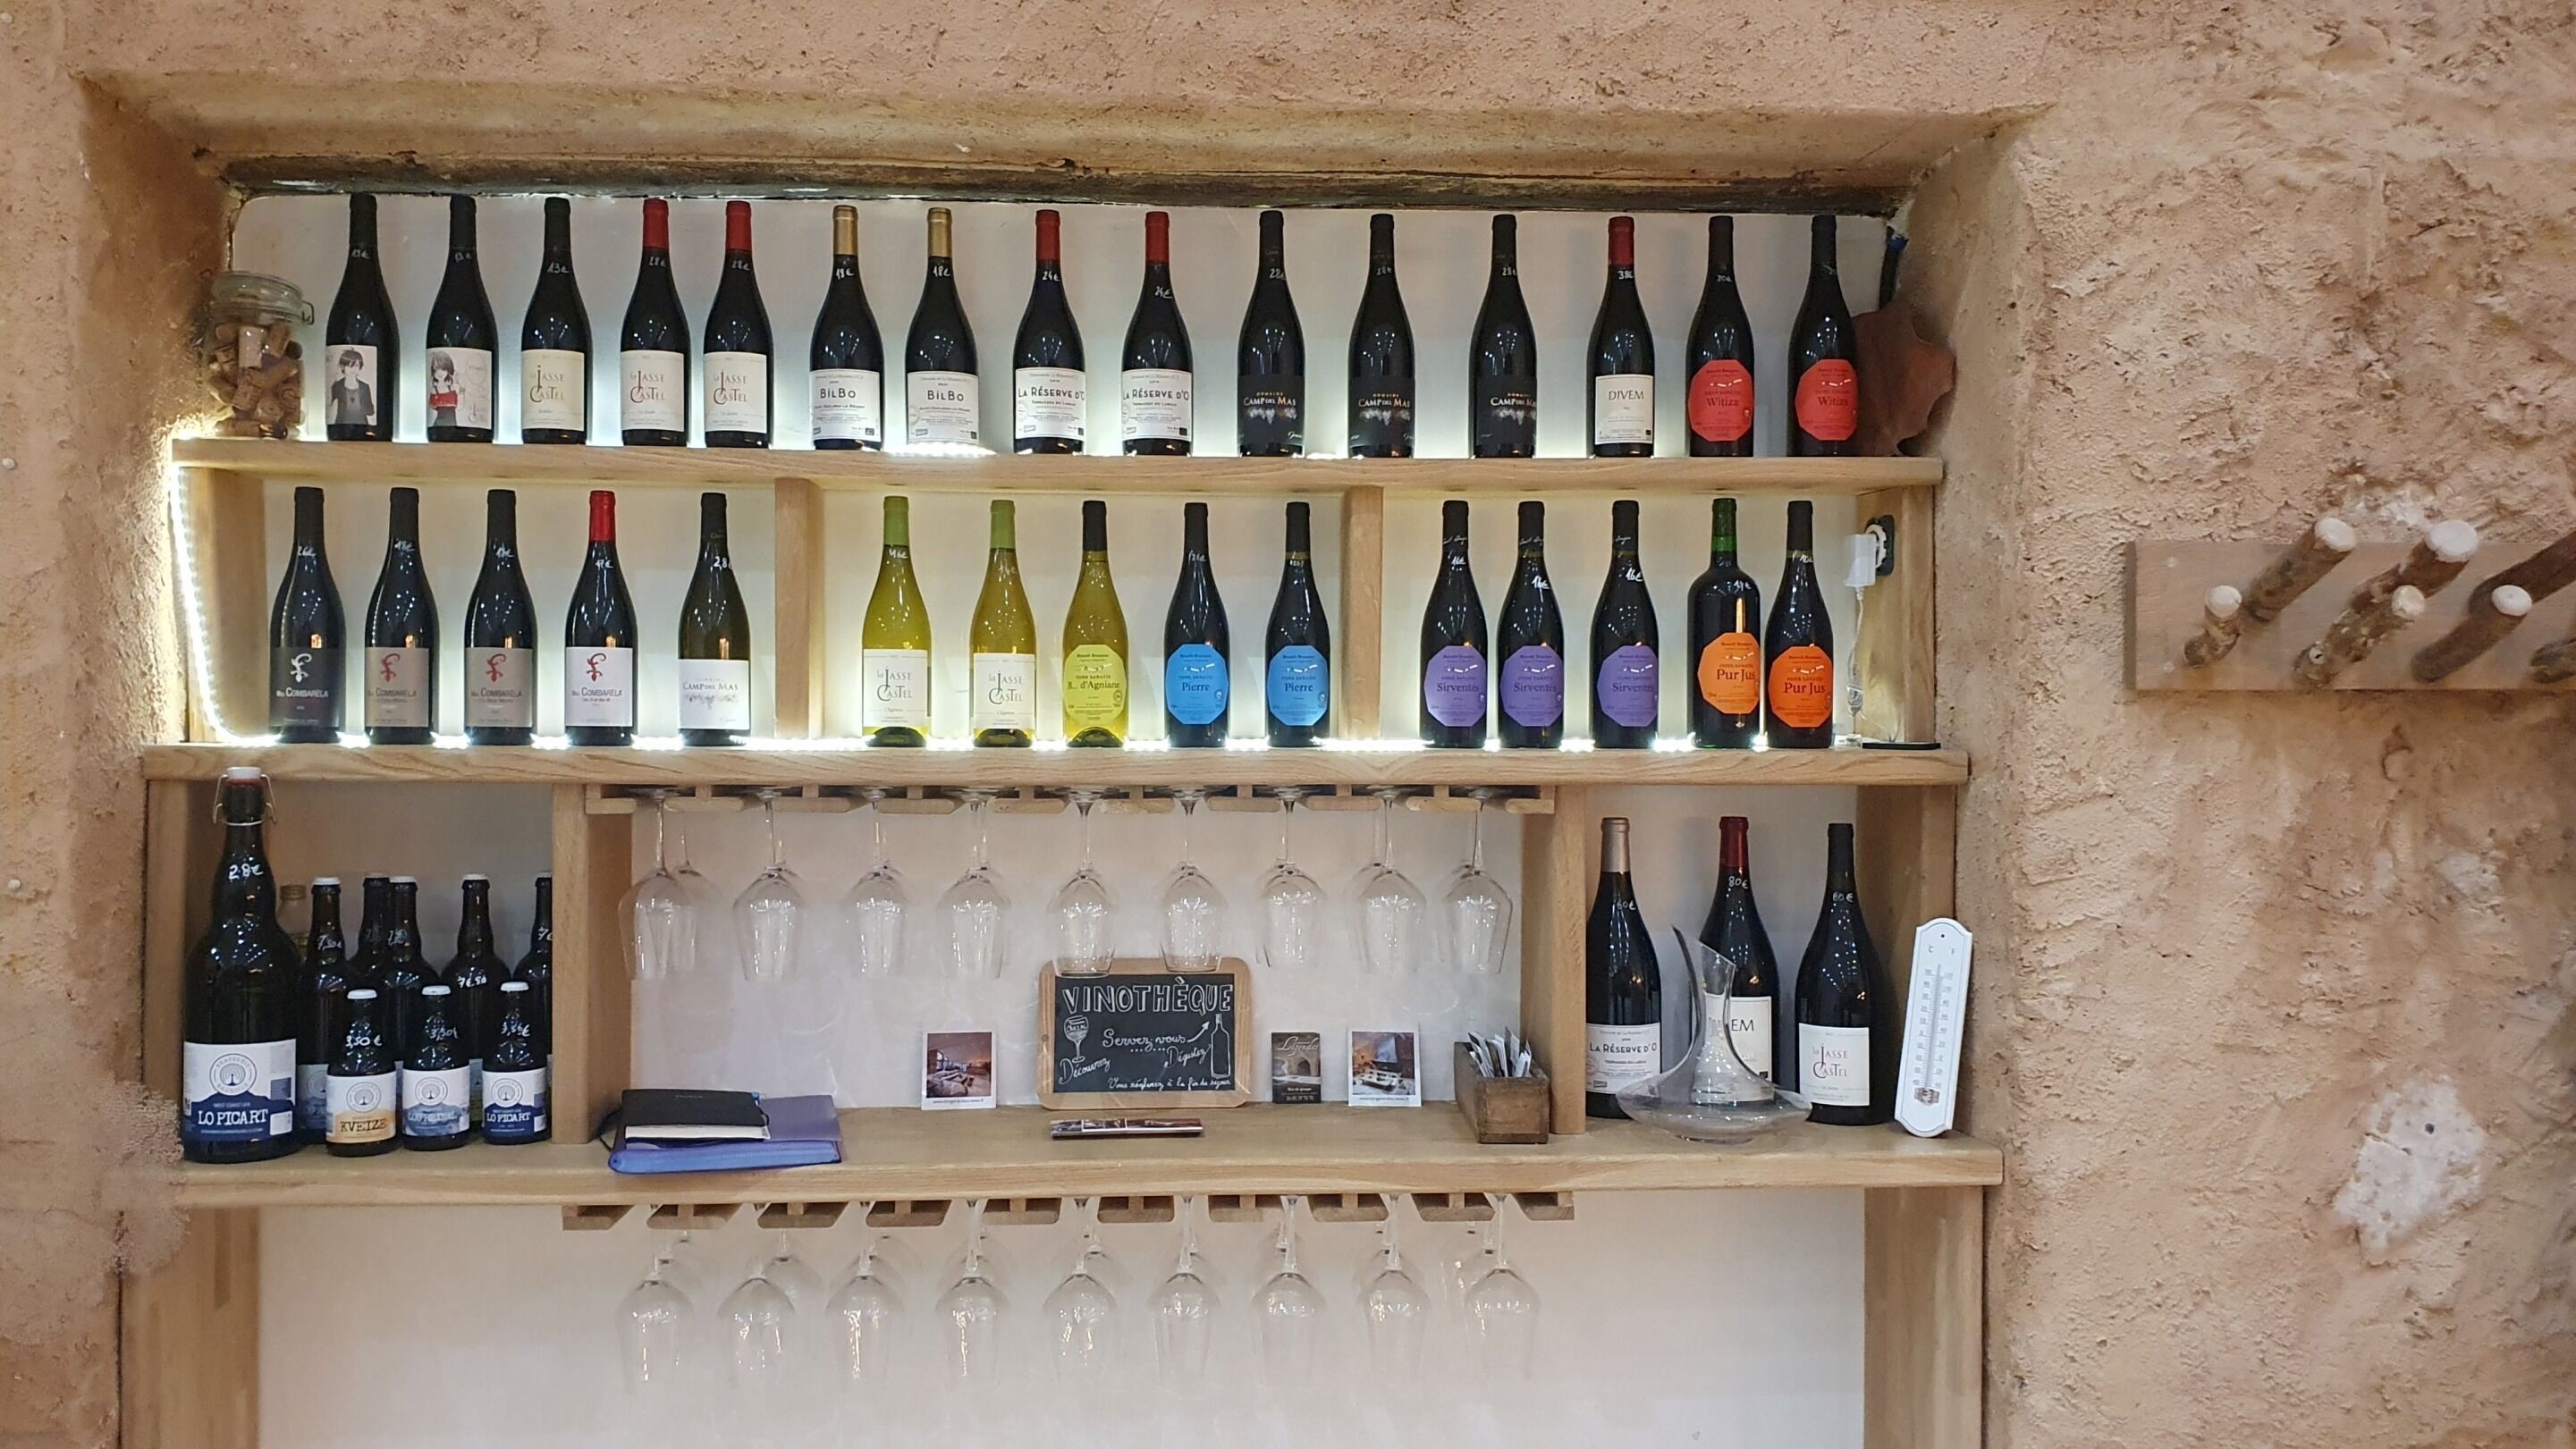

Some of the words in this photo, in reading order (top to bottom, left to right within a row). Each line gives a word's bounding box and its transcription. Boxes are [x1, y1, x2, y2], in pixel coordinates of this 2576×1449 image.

[1031, 386, 1072, 398] RÉSERVE
[1132, 388, 1173, 399] RÉSERVE
[1609, 390, 1644, 401] DIVEM
[1244, 397, 1265, 407] CAMP
[1277, 397, 1296, 406] MAS
[1358, 399, 1381, 408] CAMP
[1393, 399, 1410, 407] MAS
[1491, 397, 1516, 406] CAMP
[1626, 568, 1643, 582] 16€
[1717, 669, 1739, 680] Pur
[1741, 669, 1755, 682] Jus
[718, 682, 739, 690] MAS
[1182, 681, 1211, 692] Pierre
[1285, 682, 1313, 692] Pierre
[1784, 682, 1807, 694] Pur
[1810, 682, 1826, 695] Jus
[1728, 875, 1749, 889] 80€
[1061, 976, 1233, 1016] VINOTHÈQUE
[1603, 1043, 1643, 1054] RÉSERVE
[198, 1111, 215, 1126] LO
[215, 1108, 269, 1125] PICART
[487, 1113, 496, 1123] LO
[497, 1112, 531, 1124] PICART
